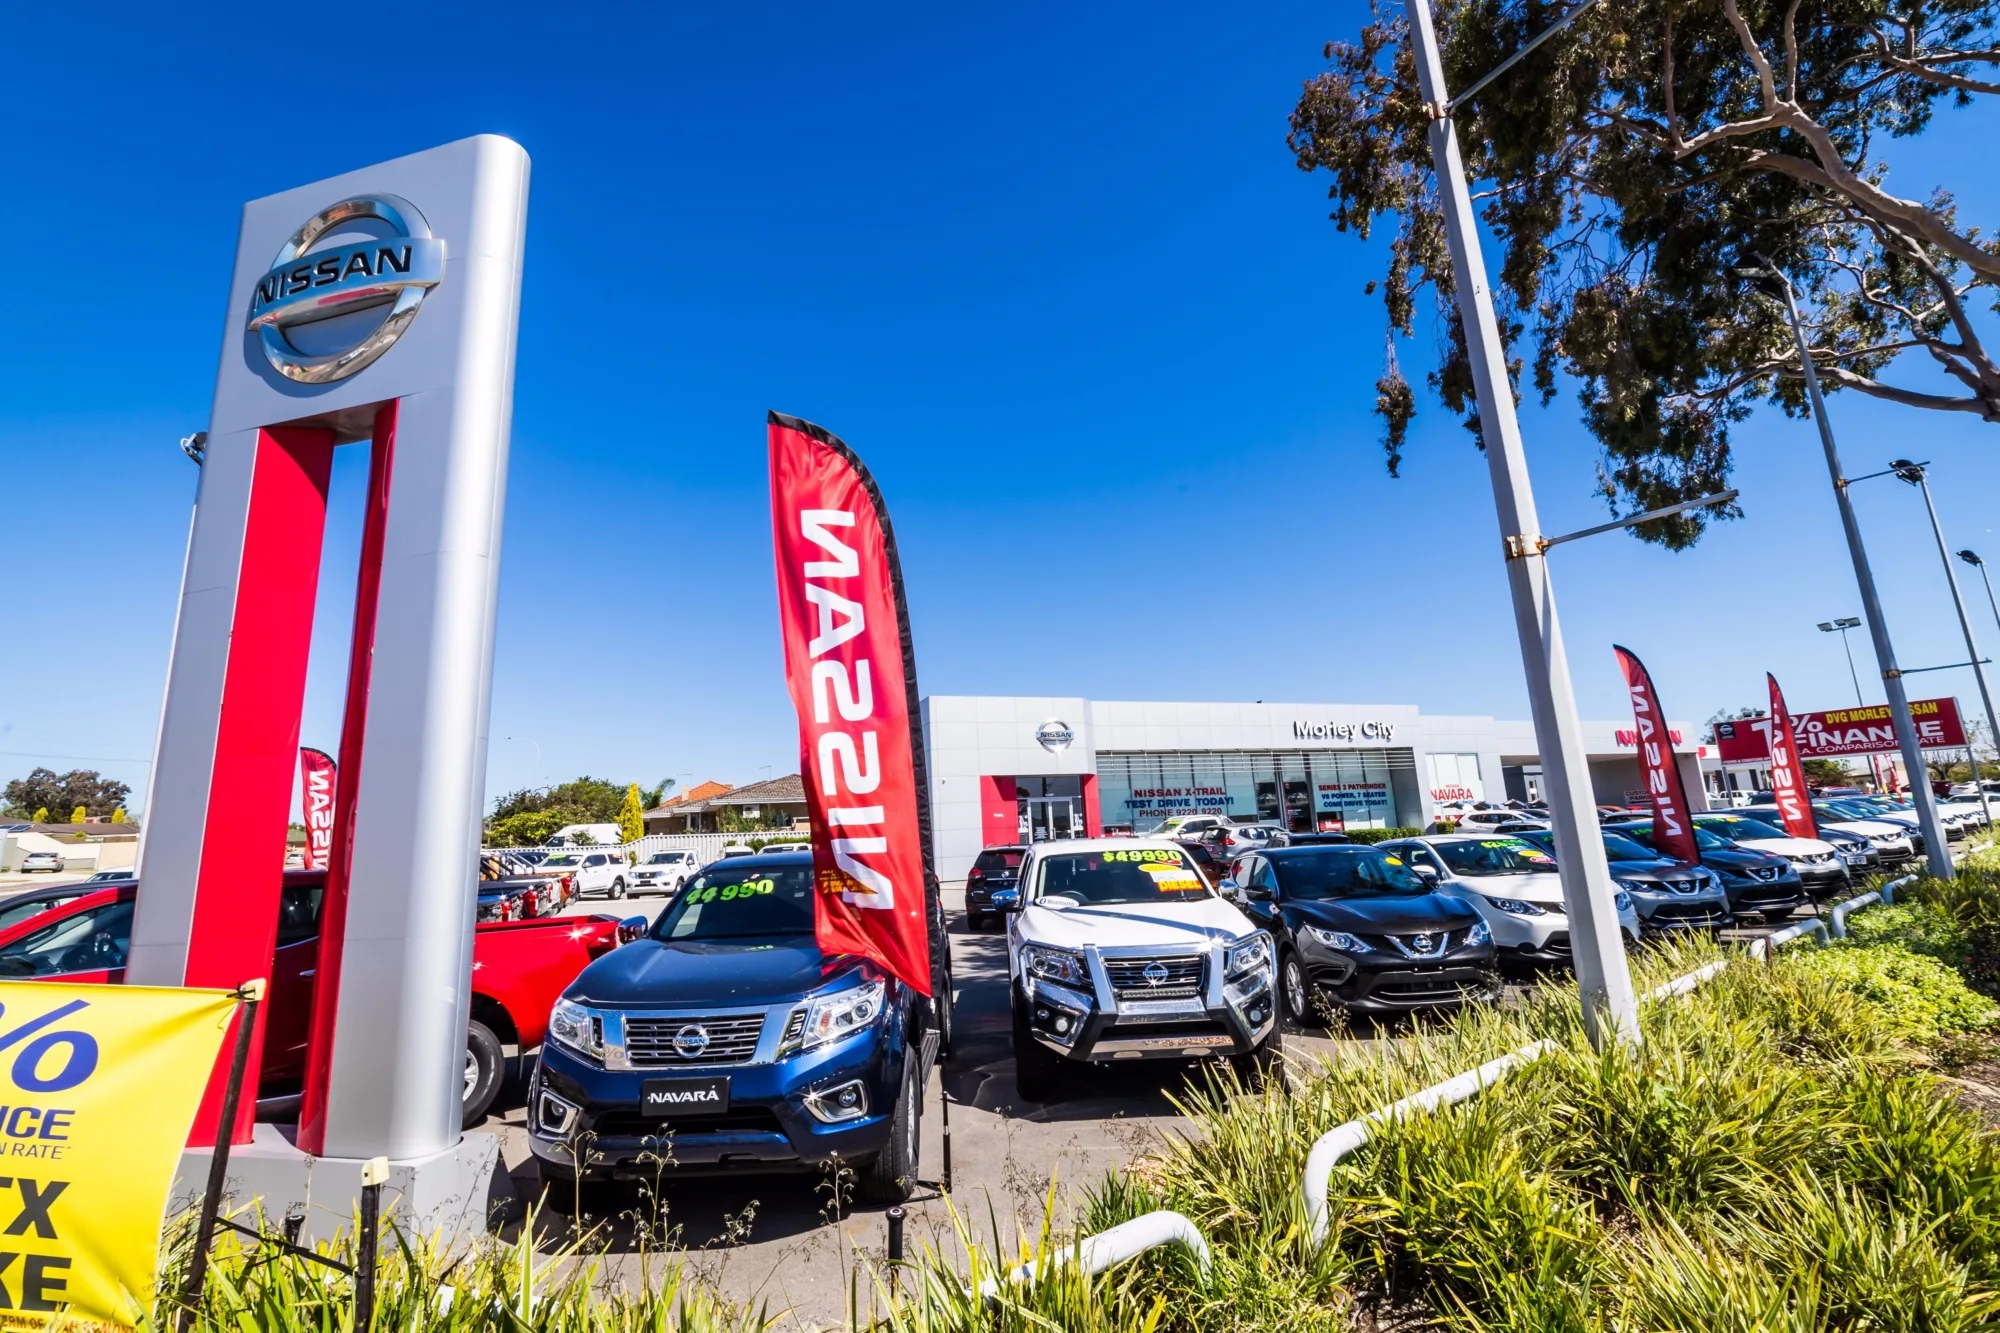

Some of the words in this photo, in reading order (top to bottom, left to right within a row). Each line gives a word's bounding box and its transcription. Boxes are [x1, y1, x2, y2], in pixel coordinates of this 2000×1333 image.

[253, 245, 412, 312] NISSAN
[1825, 711, 1848, 724] DVG
[1850, 706, 1892, 721] MORLEY
[1293, 720, 1357, 742] Morley
[1361, 720, 1396, 742] City
[1816, 739, 1899, 754] COMPARISON
[1918, 736, 1946, 746] ATE
[1134, 788, 1182, 798] NISSAN
[1185, 787, 1226, 797] X-TRAIL
[1331, 792, 1356, 800] POWER,
[1430, 788, 1474, 801] NAVARA
[1125, 800, 1152, 809] TEST
[1158, 798, 1191, 808] DRIVE
[1197, 796, 1234, 806] TODAY!
[1139, 809, 1173, 818] PHONE
[1176, 808, 1197, 816] 9220
[1201, 807, 1222, 815] 9220
[1103, 850, 1182, 862] $49990
[1159, 879, 1203, 892] DIESEL
[647, 1085, 720, 1103] NAVARA
